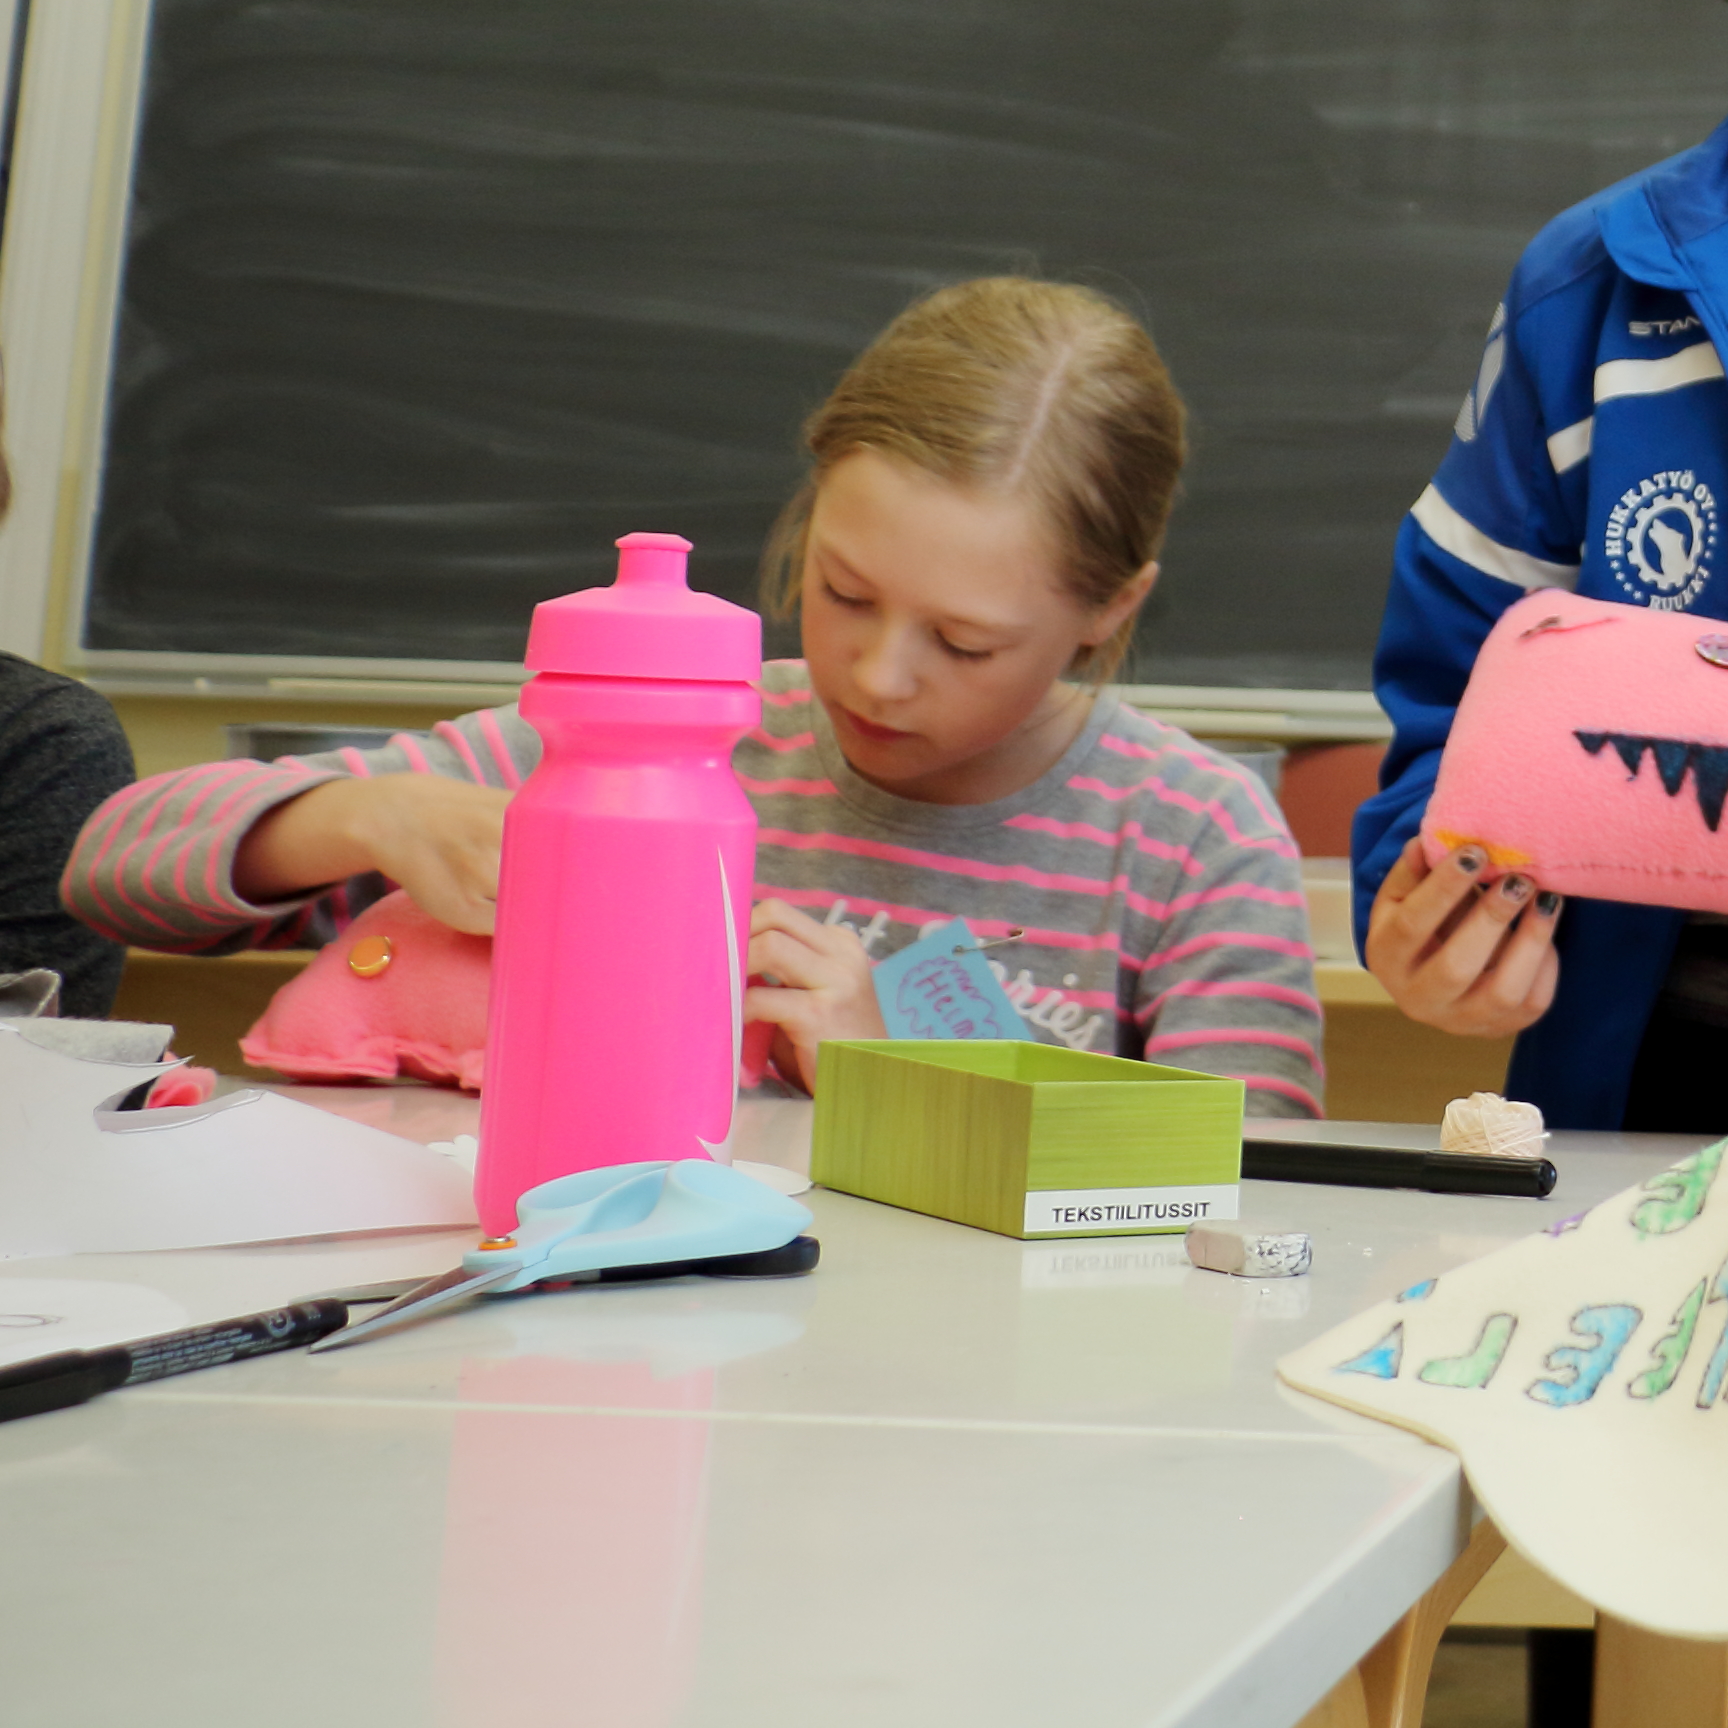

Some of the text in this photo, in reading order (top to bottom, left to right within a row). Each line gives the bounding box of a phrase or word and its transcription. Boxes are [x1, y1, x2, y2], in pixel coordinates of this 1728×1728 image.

[1605, 469, 1716, 557] HUKKATYÖ OY
[1052, 1201, 1211, 1224] TEKSTIILITUSSIT
